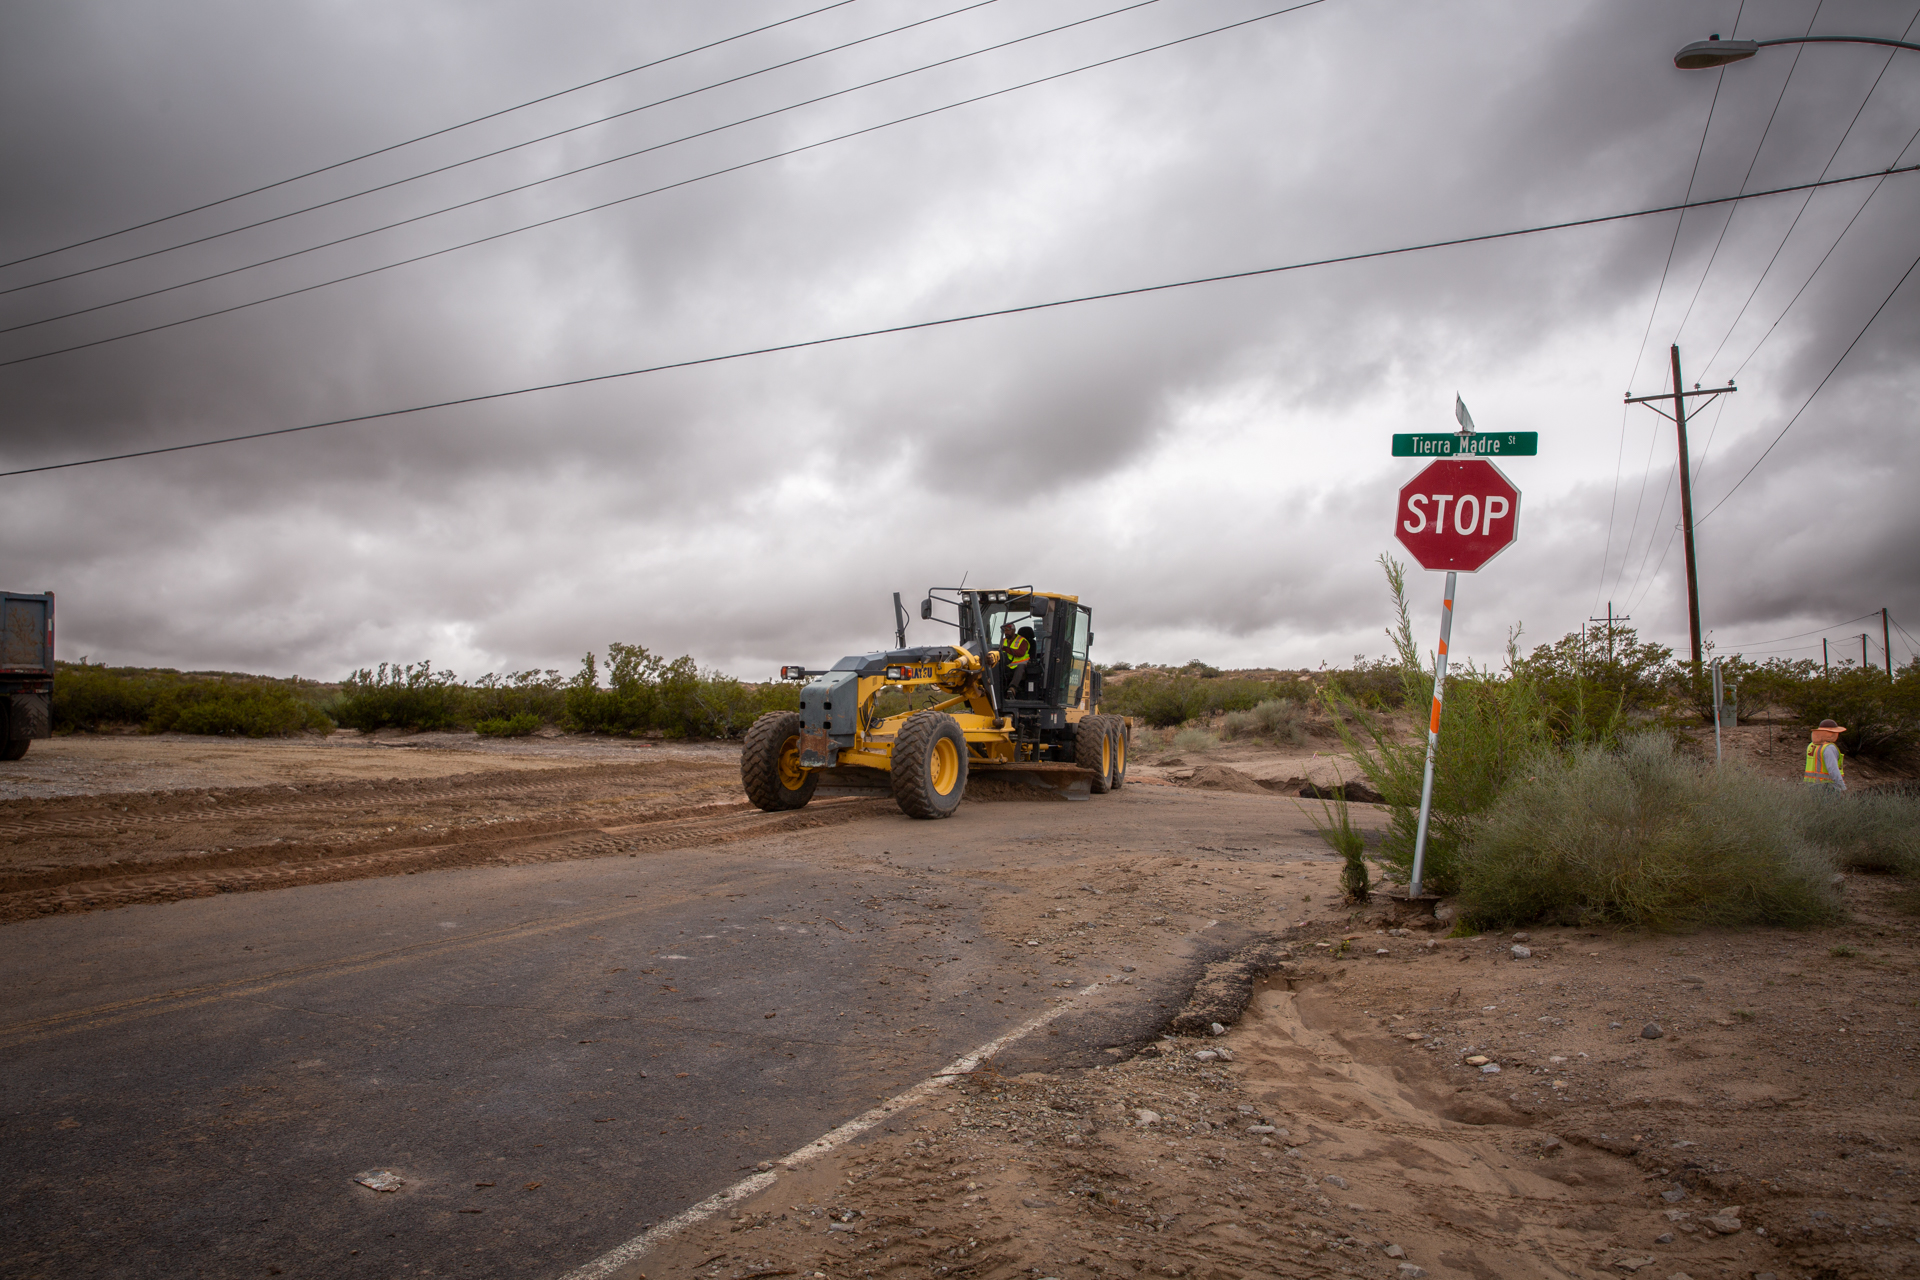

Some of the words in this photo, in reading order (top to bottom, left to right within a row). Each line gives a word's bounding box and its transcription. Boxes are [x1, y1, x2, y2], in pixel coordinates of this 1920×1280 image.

[1412, 436, 1450, 453] Tierra
[1460, 436, 1500, 453] Madre
[1508, 435, 1516, 445] St
[1403, 493, 1509, 536] STOP
